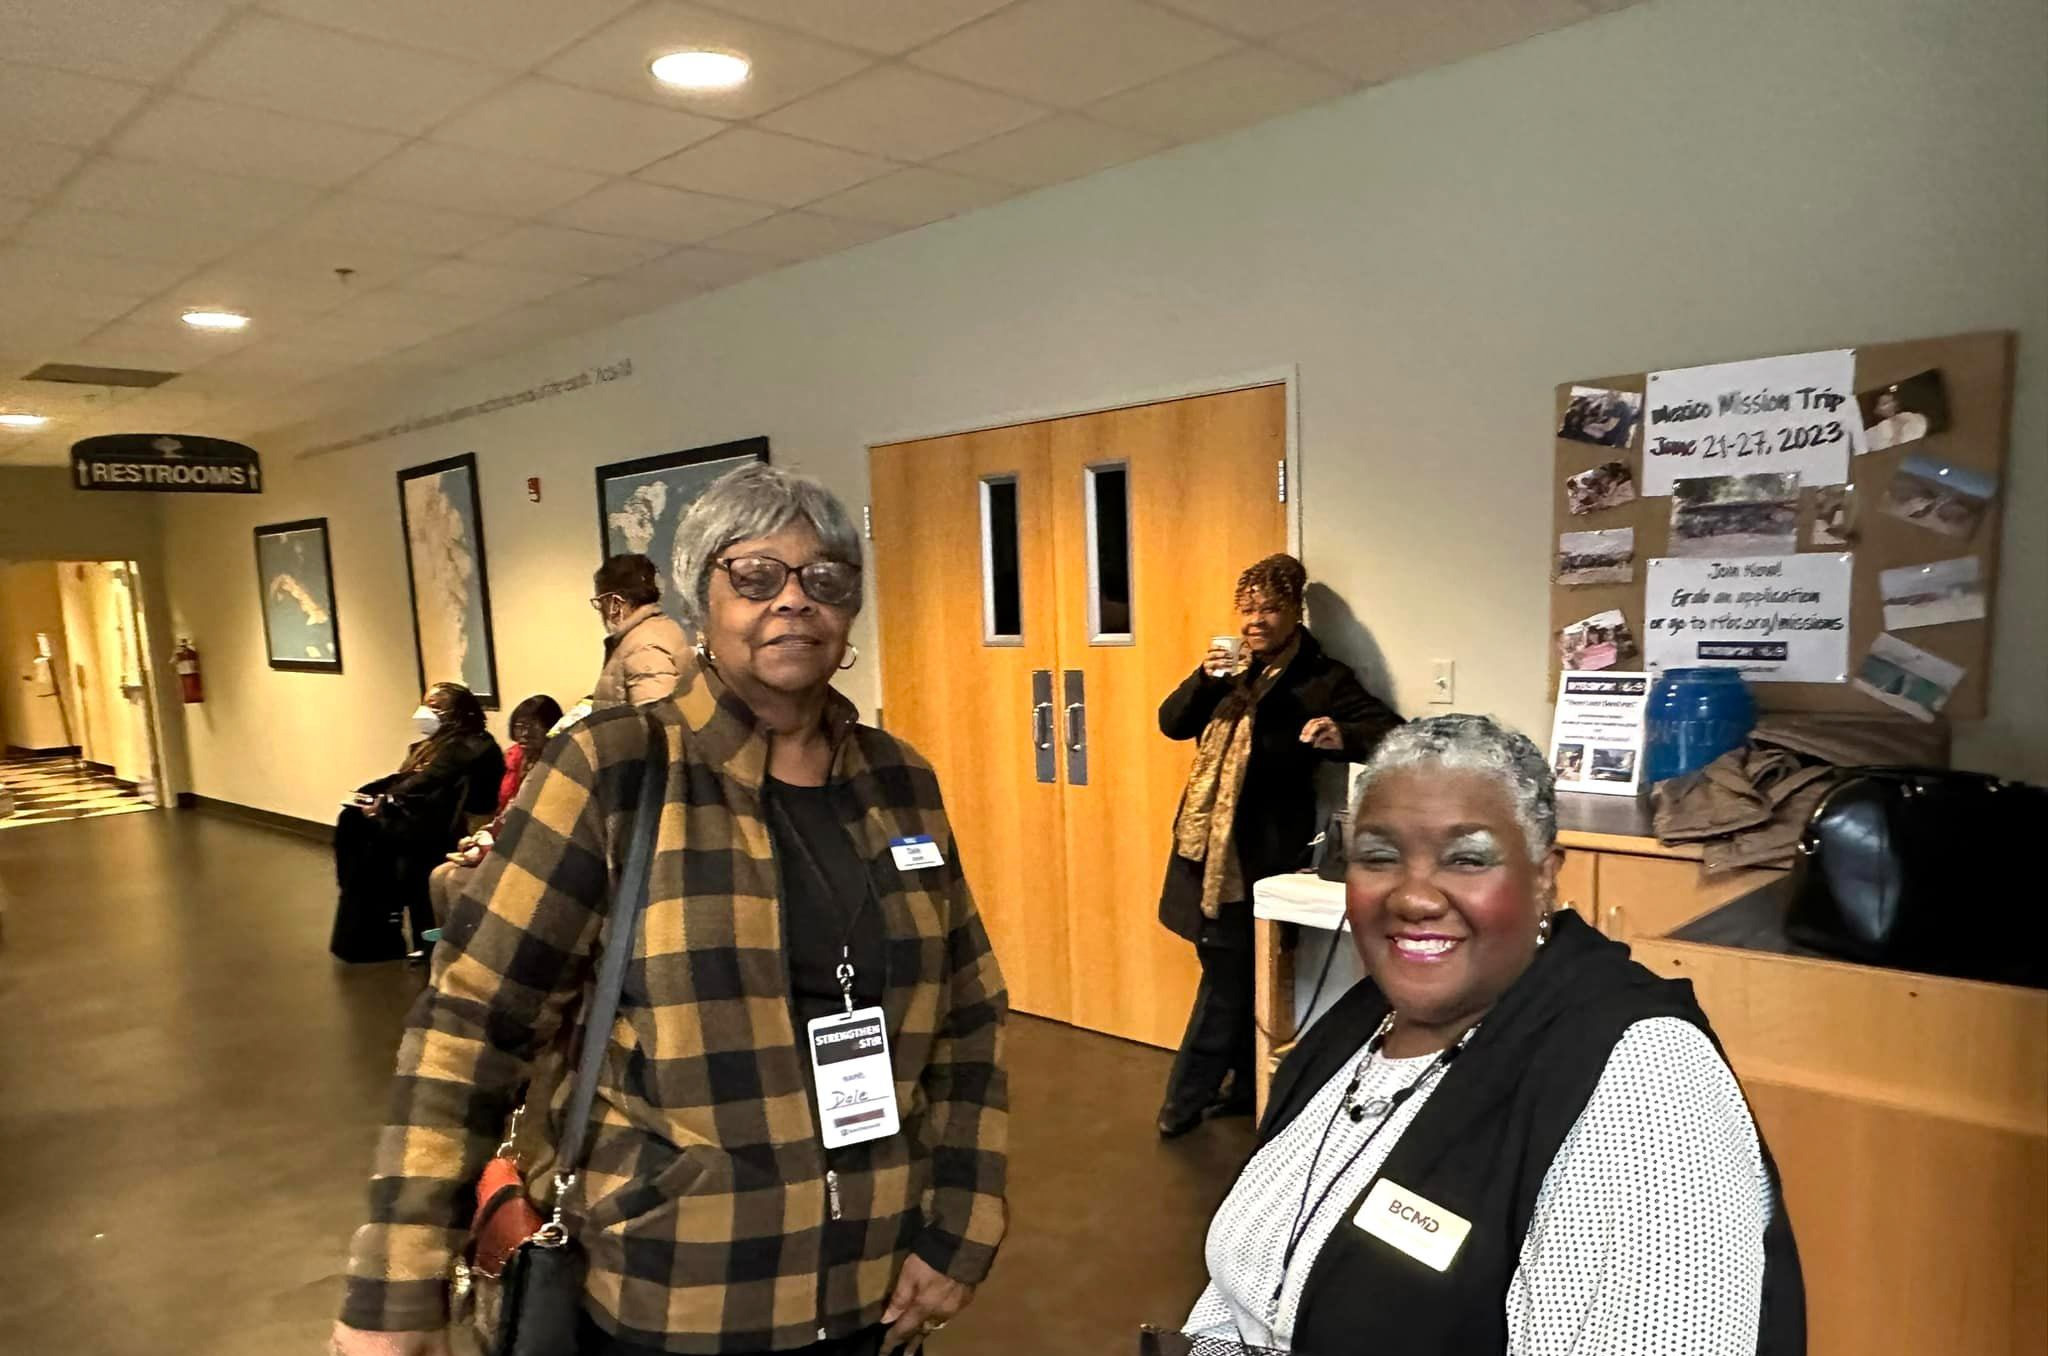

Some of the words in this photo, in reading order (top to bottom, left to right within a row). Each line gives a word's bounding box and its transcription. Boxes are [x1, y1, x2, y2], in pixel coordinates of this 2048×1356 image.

[1718, 389, 1790, 416] Mission
[1795, 387, 1845, 412] Trip
[1777, 421, 1845, 452] 2023
[92, 463, 246, 484] RESTROOMS
[1708, 563, 1740, 579] Join
[815, 1024, 881, 1046] STRENGTHEN
